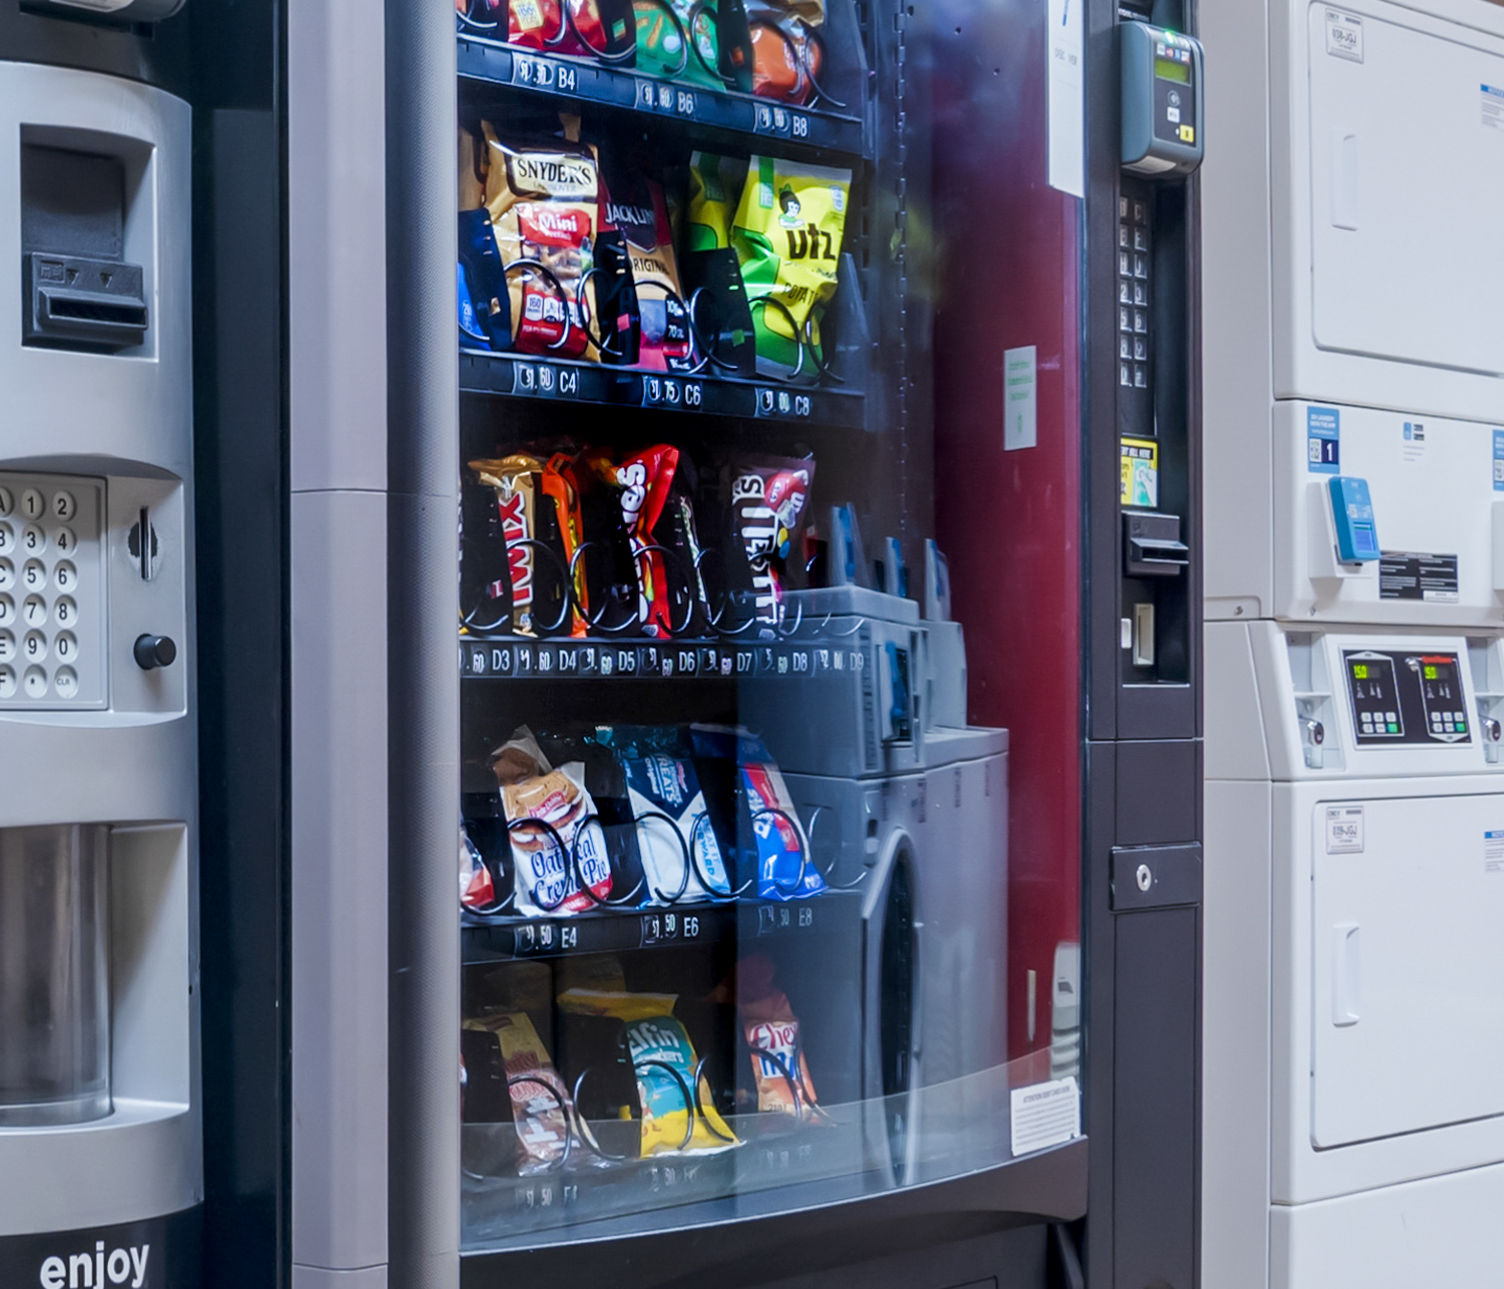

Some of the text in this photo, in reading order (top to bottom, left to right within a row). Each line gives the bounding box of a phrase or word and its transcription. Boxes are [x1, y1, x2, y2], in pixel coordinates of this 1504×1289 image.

[558, 68, 575, 90] B4
[678, 91, 693, 114] B6
[793, 115, 807, 137] B8
[517, 158, 592, 186] SNYDER'S
[538, 212, 579, 232] Mini
[605, 203, 635, 225] JACK
[559, 370, 576, 393] C4
[685, 384, 701, 406] C6
[795, 395, 809, 416] C8
[1326, 442, 1333, 462] 1
[27, 496, 35, 514] 1
[57, 498, 68, 516] 2
[26, 531, 37, 549] 3
[57, 533, 68, 550] 4
[27, 567, 37, 585] 5
[58, 568, 68, 586] 6
[27, 602, 37, 619] 7
[58, 603, 68, 621] 8
[28, 638, 38, 656] 9
[58, 638, 68, 656] 0
[492, 649, 510, 671] D3
[559, 649, 577, 671] D4
[618, 651, 635, 672] D5
[679, 651, 695, 671] D6
[737, 652, 752, 671] D7
[793, 652, 807, 671] D8
[850, 652, 865, 671] D9
[799, 907, 812, 927] E8
[561, 927, 577, 948] E4
[684, 917, 699, 938] E6
